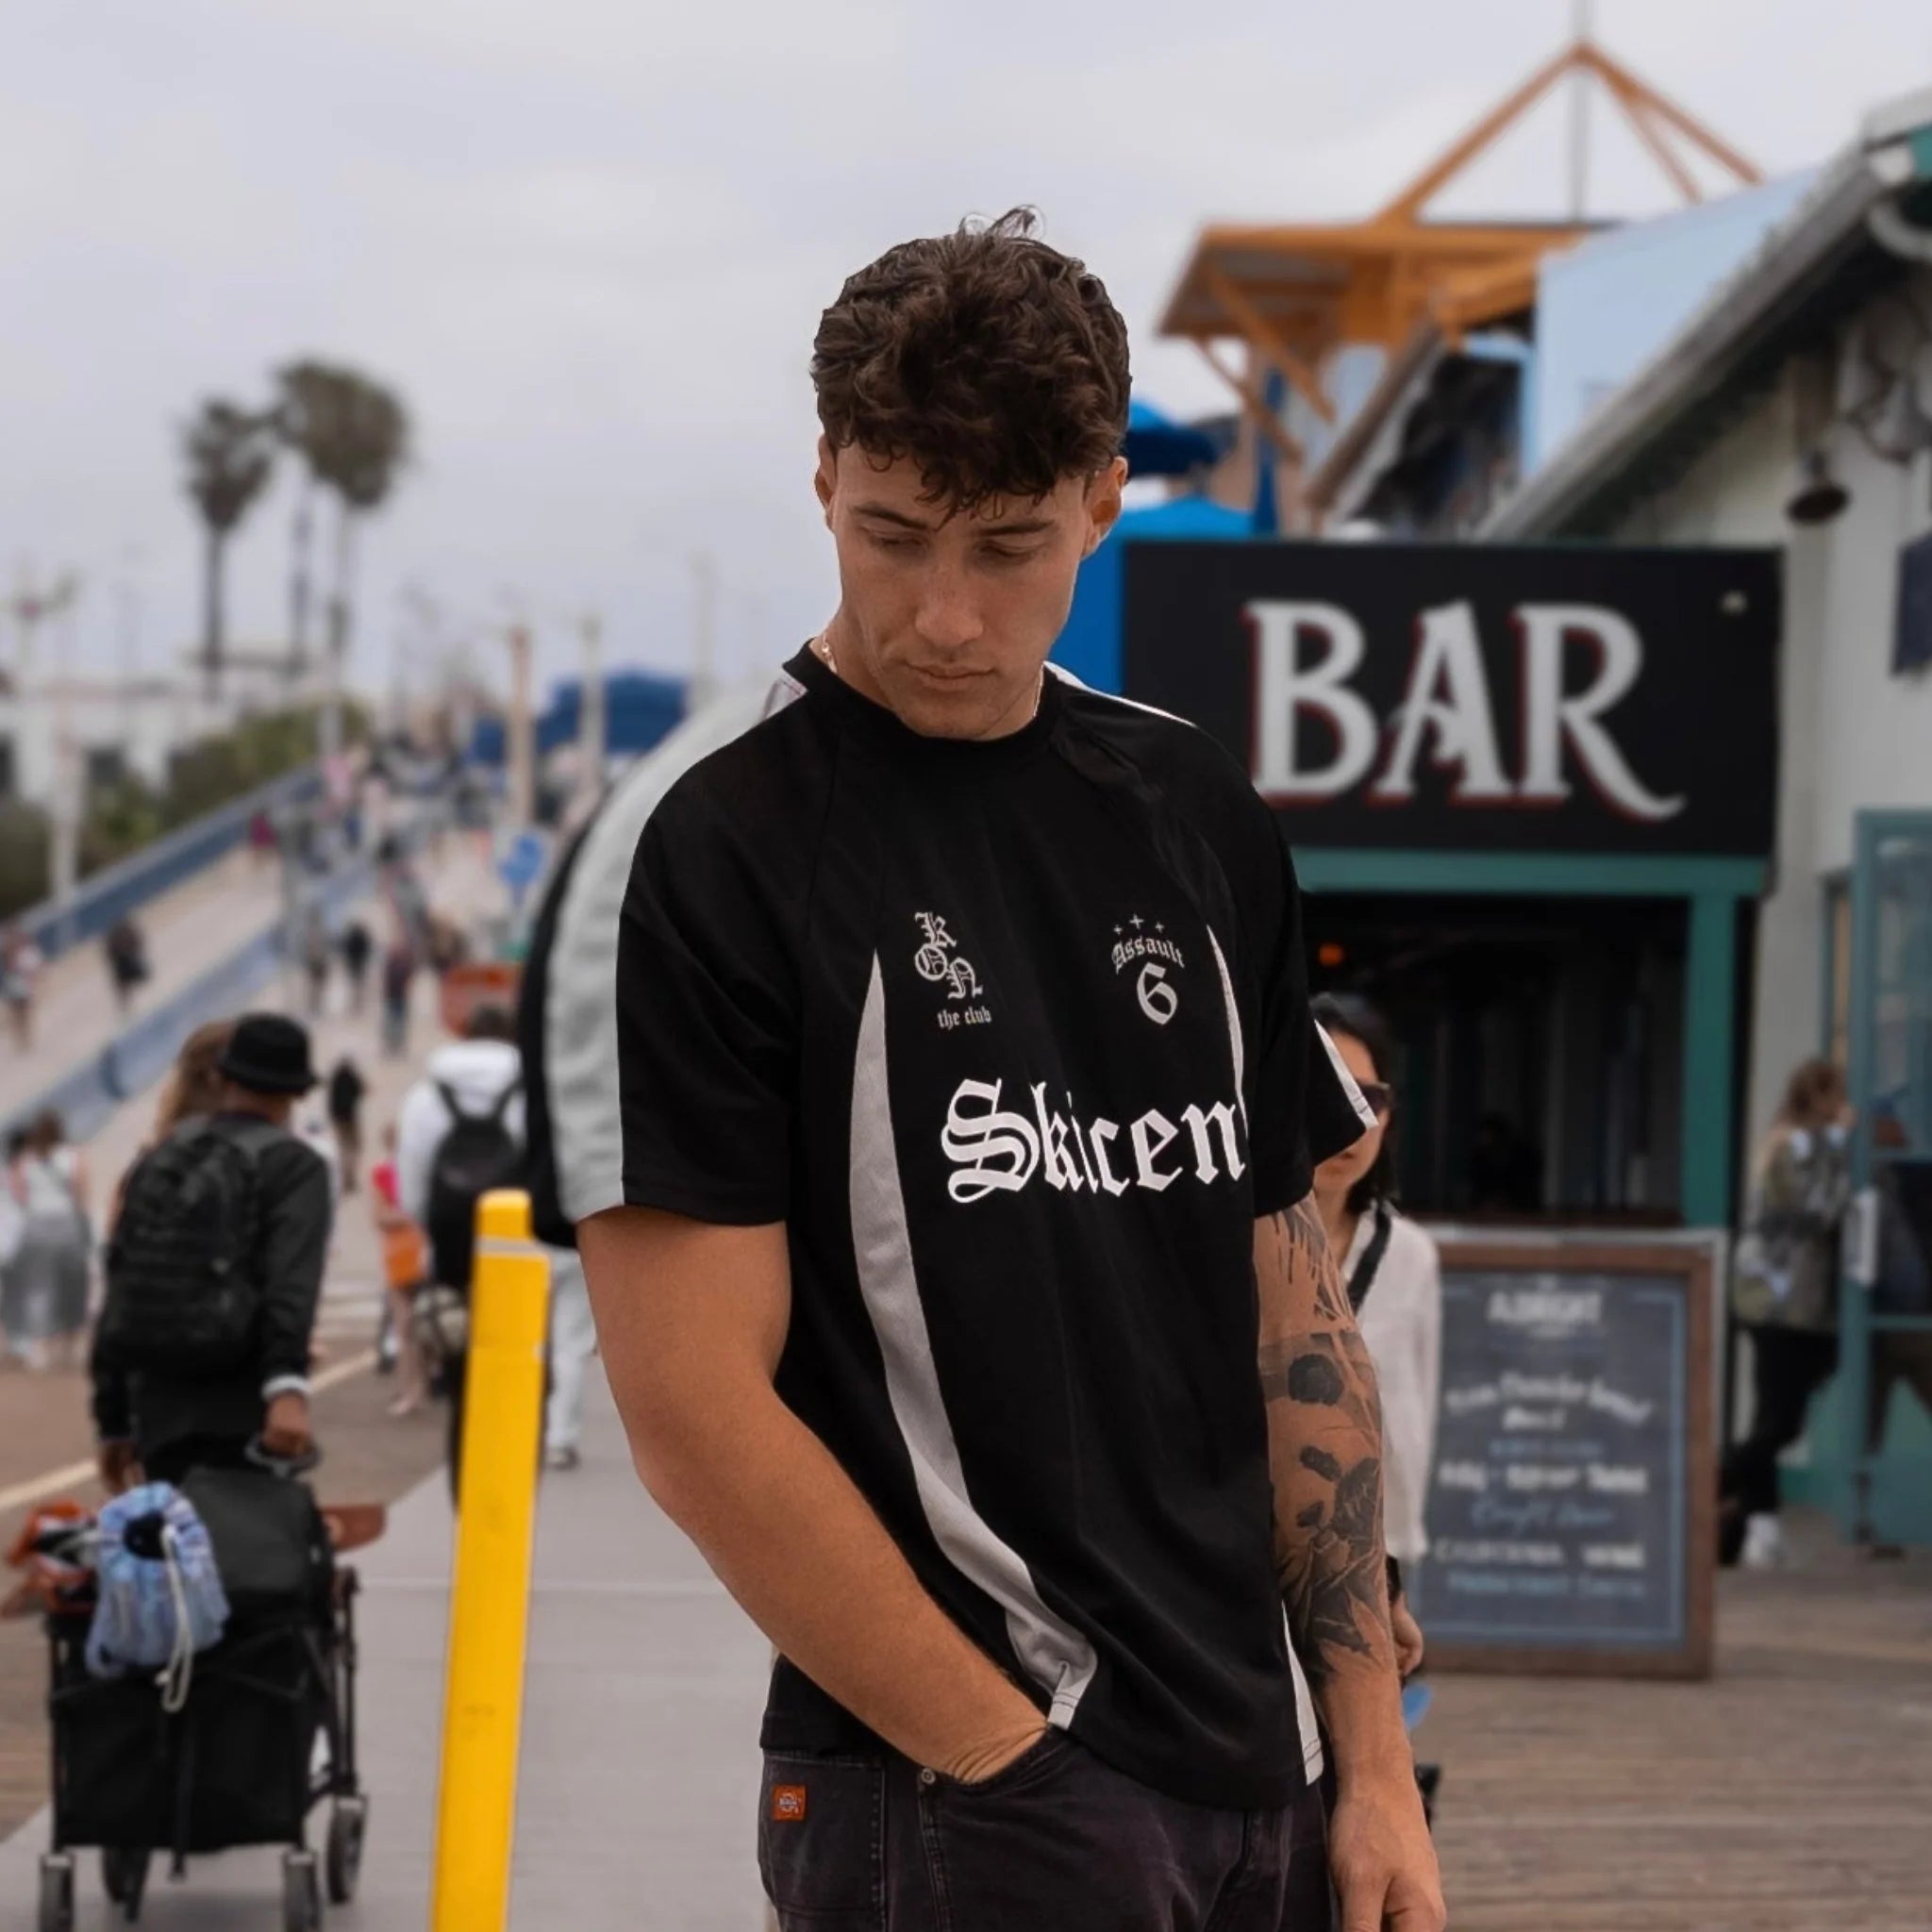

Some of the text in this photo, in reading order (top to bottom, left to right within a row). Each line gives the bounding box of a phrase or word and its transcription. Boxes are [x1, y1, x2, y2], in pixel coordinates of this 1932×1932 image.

[1240, 598, 1687, 821] BAR
[1111, 935, 1186, 975] Assault
[937, 1005, 992, 1030] the club
[1136, 961, 1178, 1025] 6
